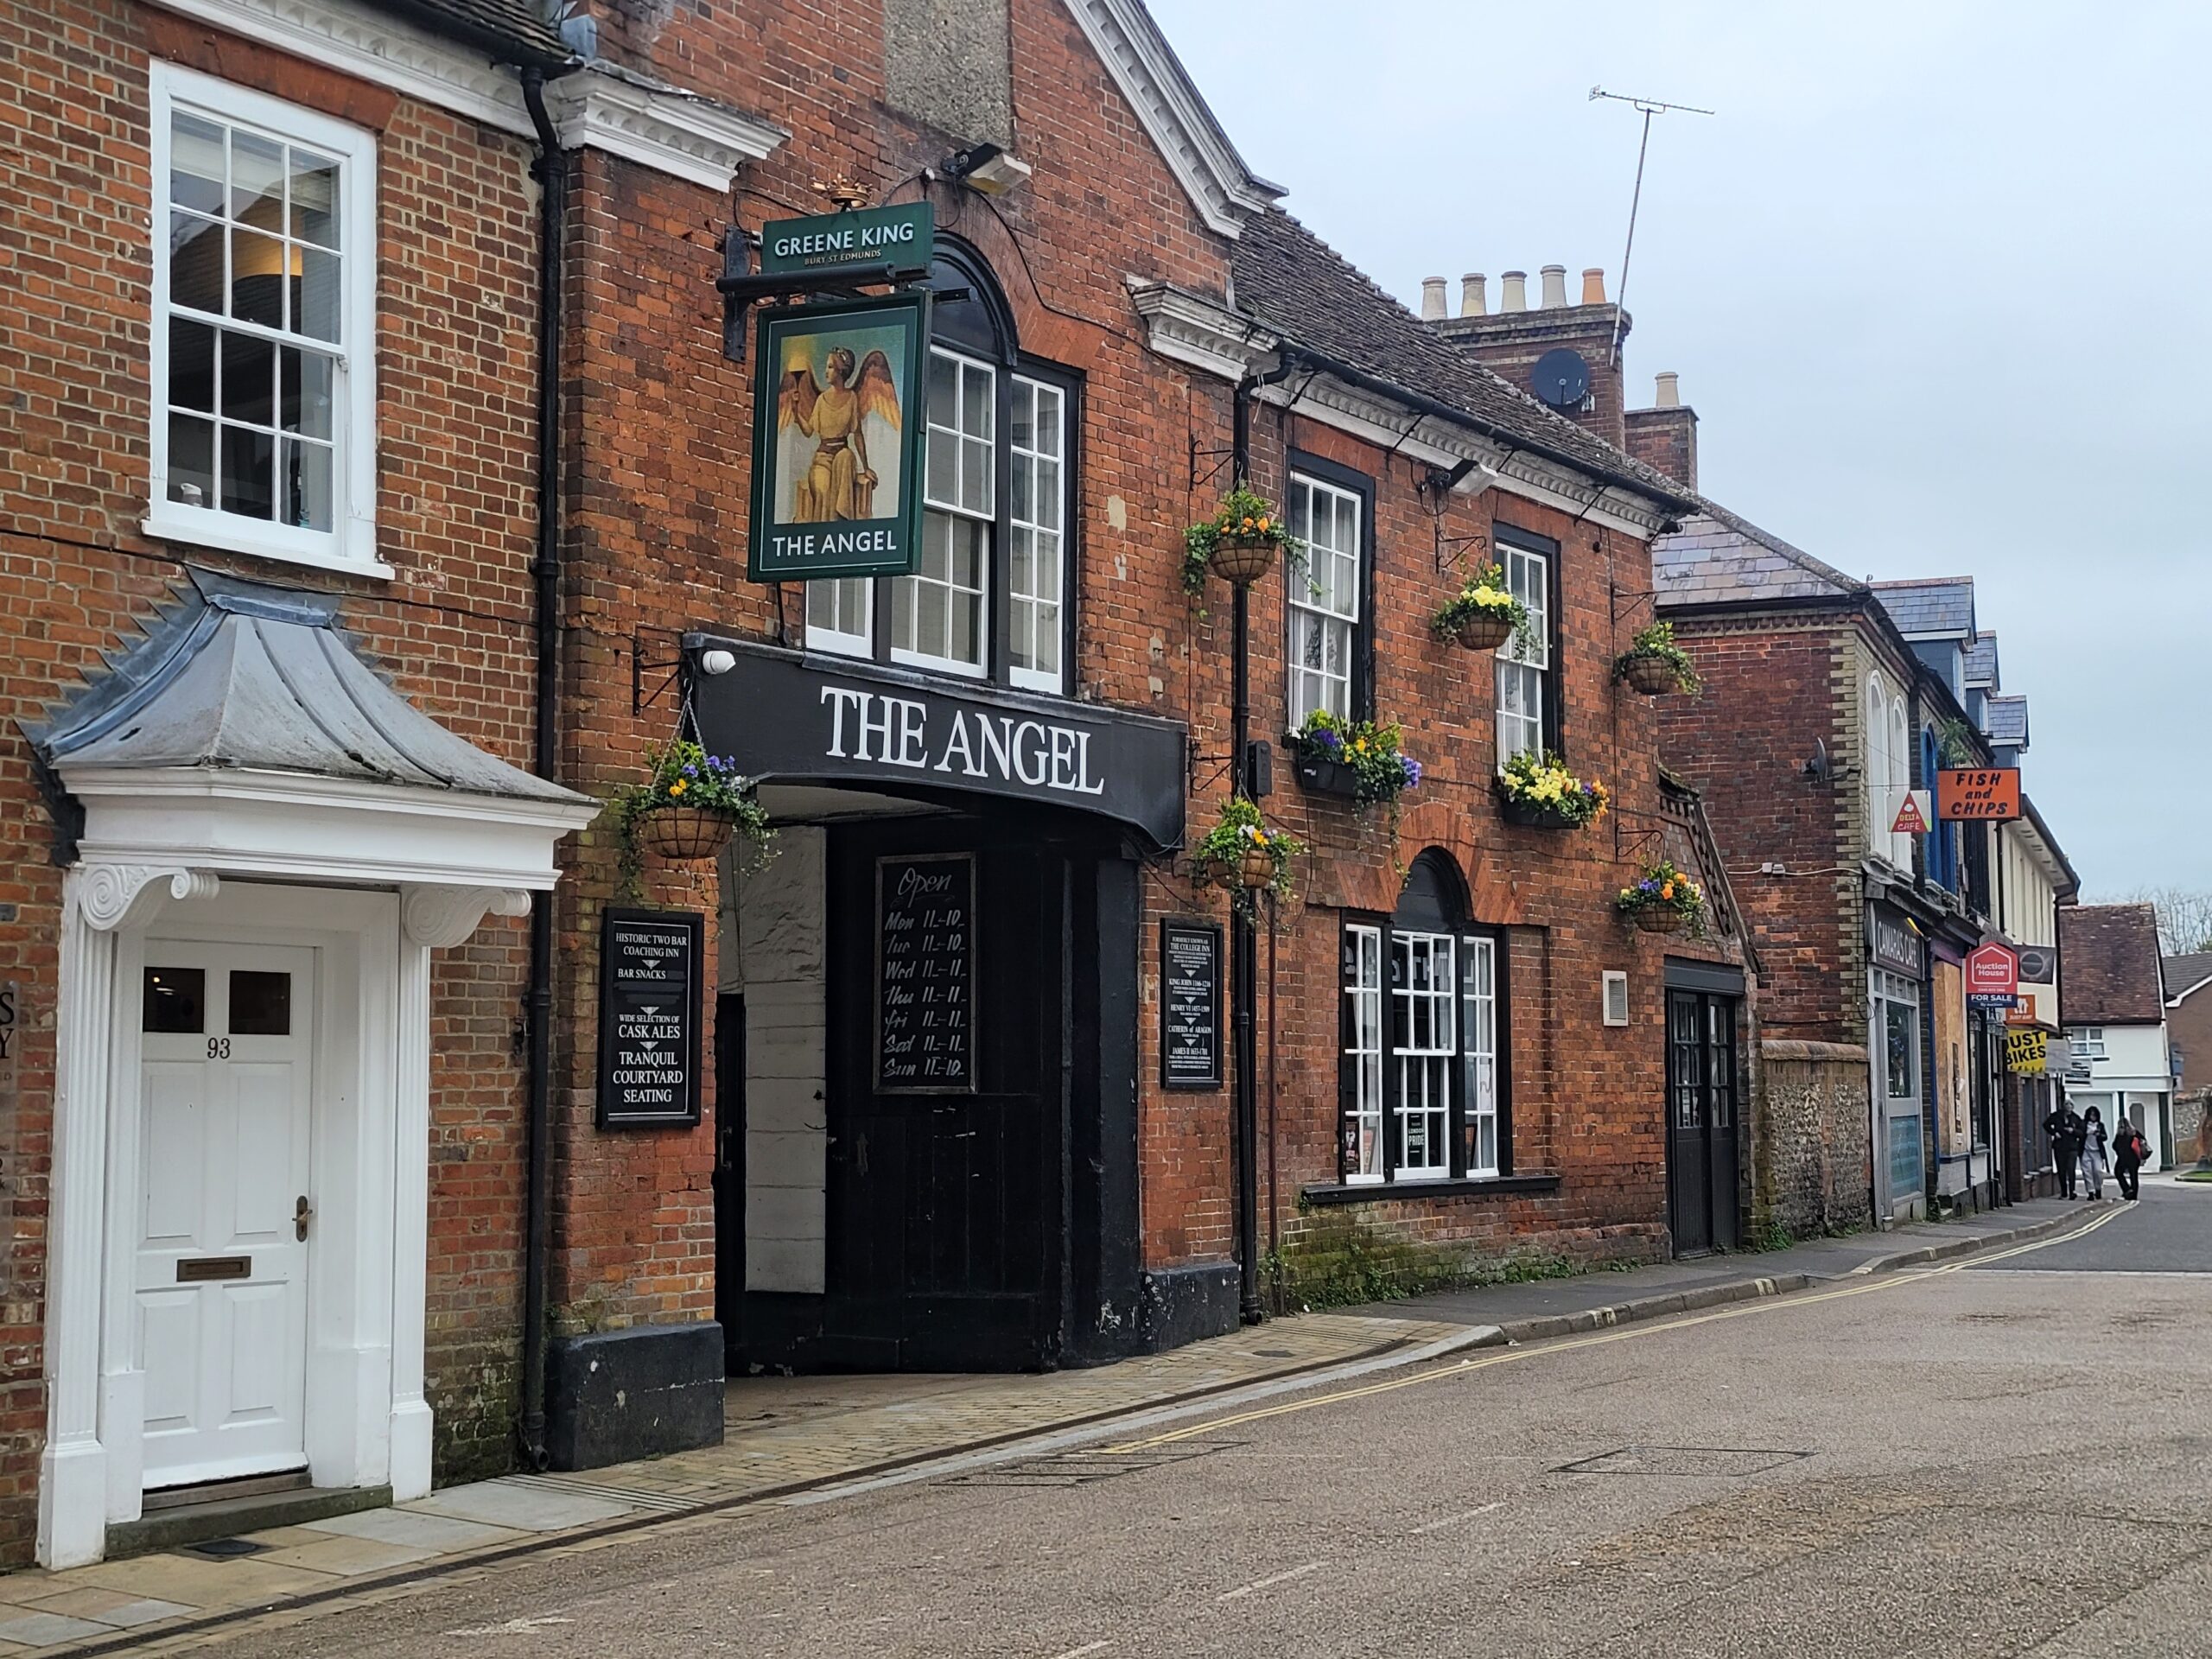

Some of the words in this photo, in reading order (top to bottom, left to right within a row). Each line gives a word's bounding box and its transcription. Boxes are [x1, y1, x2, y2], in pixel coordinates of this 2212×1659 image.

[774, 230, 854, 257] GREENE
[861, 222, 914, 246] KING
[804, 257, 826, 265] BURY
[840, 249, 882, 262] EDMUNDS
[772, 534, 815, 557] THE
[820, 530, 897, 555] ANGEL
[820, 685, 929, 769] THE
[933, 709, 1105, 796] ANGEL
[1955, 772, 2001, 786] FISH
[1965, 787, 1993, 800] and
[1951, 802, 2008, 816] CHIPS
[1899, 813, 1921, 822] DELTA
[1897, 822, 1921, 831] CAFE
[897, 867, 952, 908] Open
[884, 912, 915, 931] Mon
[615, 932, 652, 944] HISTORIC
[653, 934, 671, 945] TWO
[671, 936, 688, 946] BAR
[623, 946, 664, 957] COACHING
[665, 947, 679, 958] INN
[1170, 942, 1179, 950] THE
[1179, 943, 1201, 952] COLLEGE
[618, 968, 634, 978] BAR
[635, 969, 666, 979] SNACKS
[886, 961, 917, 979] Wed
[884, 986, 914, 1005] Thu
[619, 1014, 636, 1023] WIDE
[637, 1014, 671, 1023] SELECTION
[884, 1009, 908, 1036] Fri
[619, 1024, 650, 1039] CASK
[652, 1025, 680, 1039] ALES
[884, 1034, 916, 1053] Sat
[2006, 1031, 2042, 1049] UST
[207, 1037, 232, 1059] 93
[619, 1052, 678, 1068] TRANQUIL
[883, 1058, 916, 1077] Sun
[613, 1071, 683, 1084] COURTYARD
[623, 1089, 672, 1103] SEATING
[1408, 1135, 1425, 1147] PRIDE
